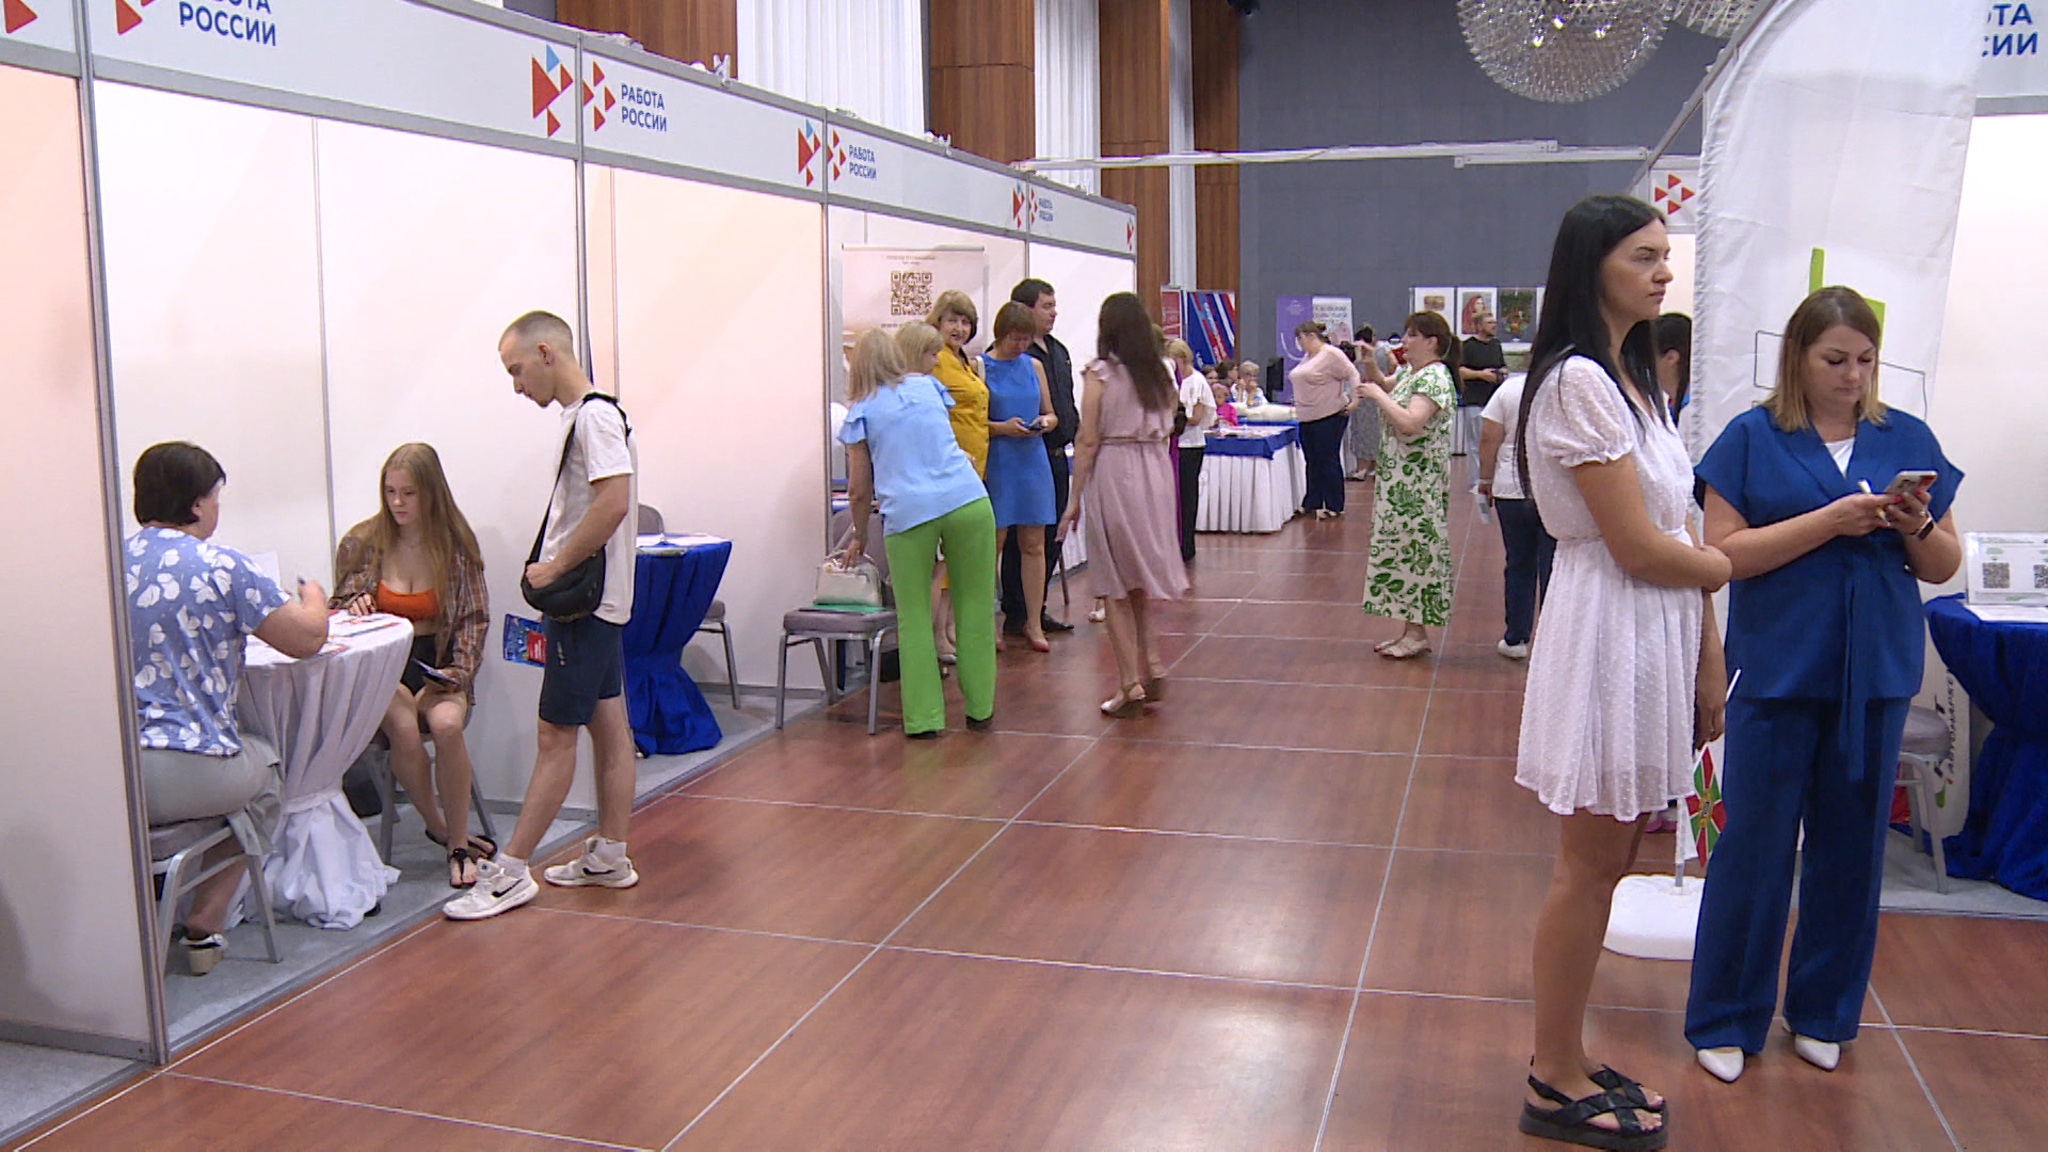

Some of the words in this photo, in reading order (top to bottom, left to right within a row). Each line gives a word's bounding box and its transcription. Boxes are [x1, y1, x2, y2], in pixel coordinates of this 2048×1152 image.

[179, 1, 276, 46] РОССИИ
[1987, 3, 2033, 26] ТА
[1982, 32, 2038, 57] ИИ
[621, 83, 665, 110] РАБОТА
[621, 106, 667, 132] РОССИИ
